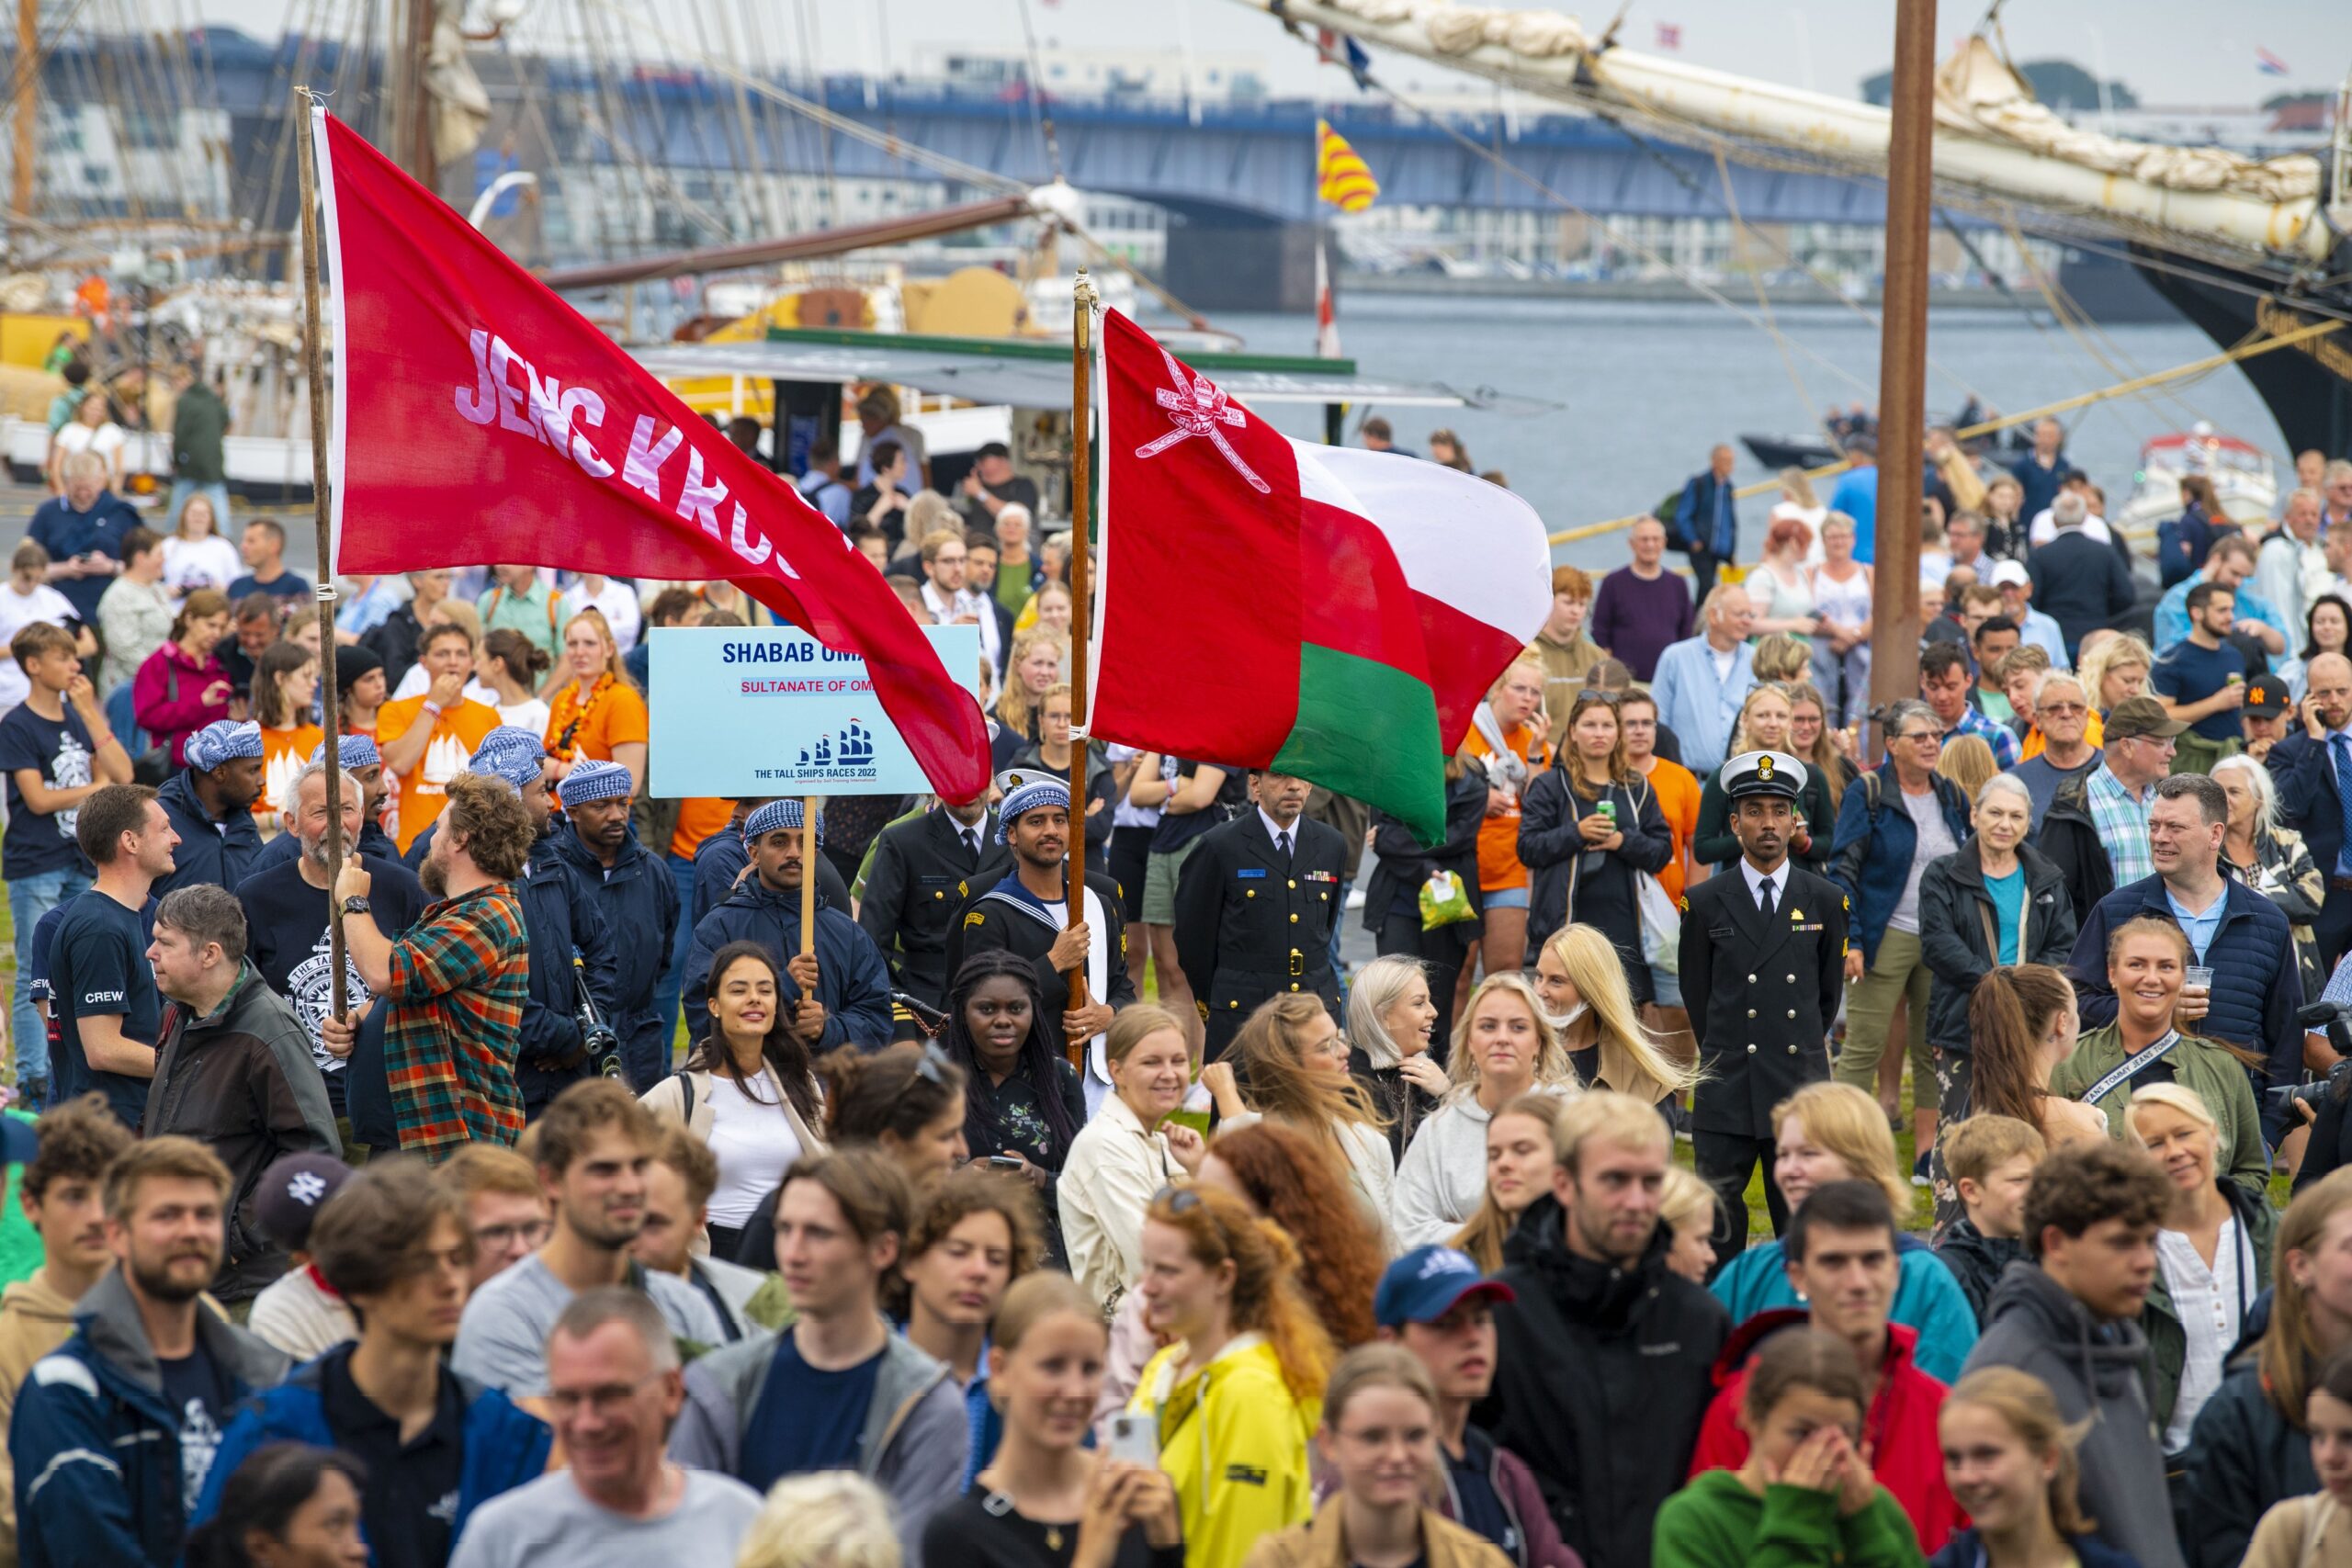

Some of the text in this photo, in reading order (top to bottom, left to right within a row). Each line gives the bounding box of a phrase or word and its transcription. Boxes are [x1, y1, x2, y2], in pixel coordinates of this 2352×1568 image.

[723, 642, 814, 663] SHABAB
[741, 681, 824, 693] SULTANATE
[828, 680, 846, 692] OF
[754, 768, 876, 779] THE TALL SHIPS RACES 2022
[292, 963, 313, 979] THE
[315, 955, 333, 966] TAL
[85, 991, 124, 1004] CREW
[2105, 1066, 2132, 1086] TOMMY
[2132, 1050, 2154, 1069] JEANS
[2154, 1033, 2175, 1053] TOMMY
